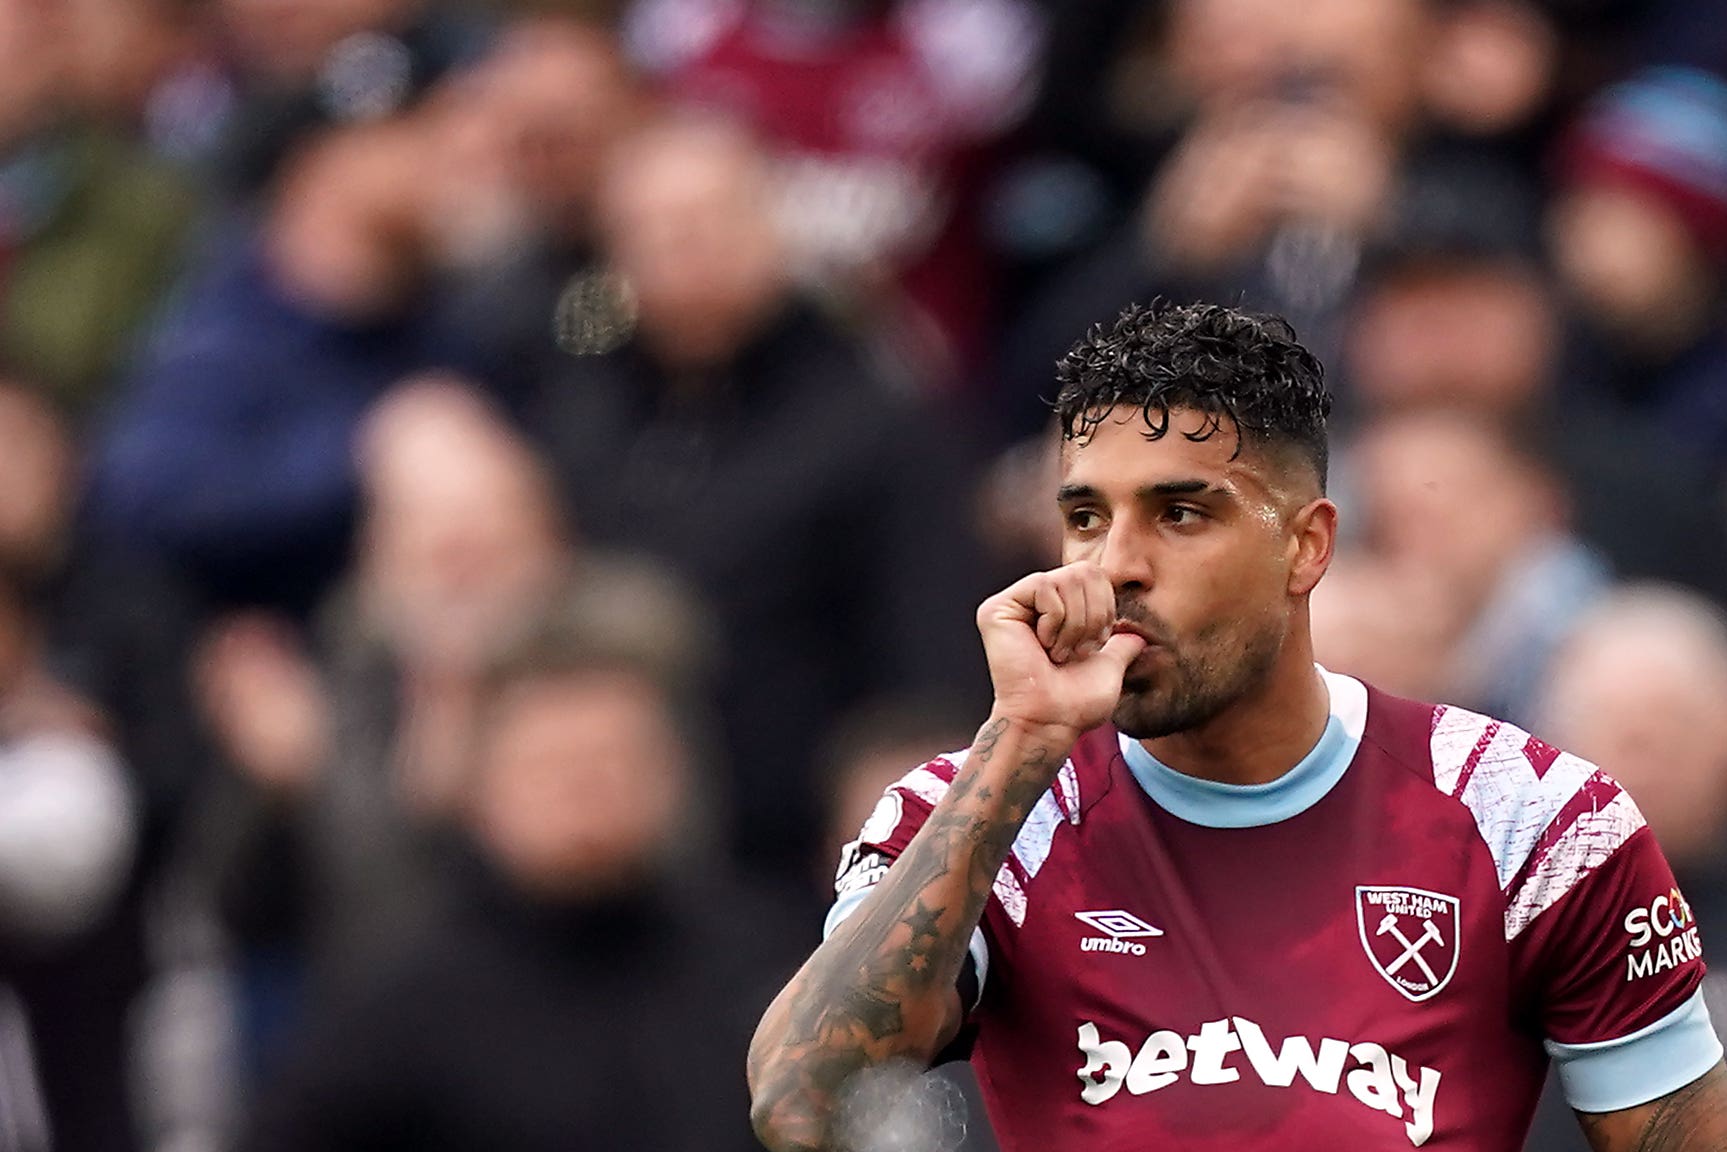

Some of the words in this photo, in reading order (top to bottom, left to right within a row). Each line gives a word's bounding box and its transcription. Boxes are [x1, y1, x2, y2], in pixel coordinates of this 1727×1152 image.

[1367, 892, 1409, 905] WEST
[1411, 895, 1448, 915] HAM
[1386, 903, 1432, 918] UNITED
[1080, 937, 1147, 956] umbro
[1077, 1016, 1442, 1147] betway
